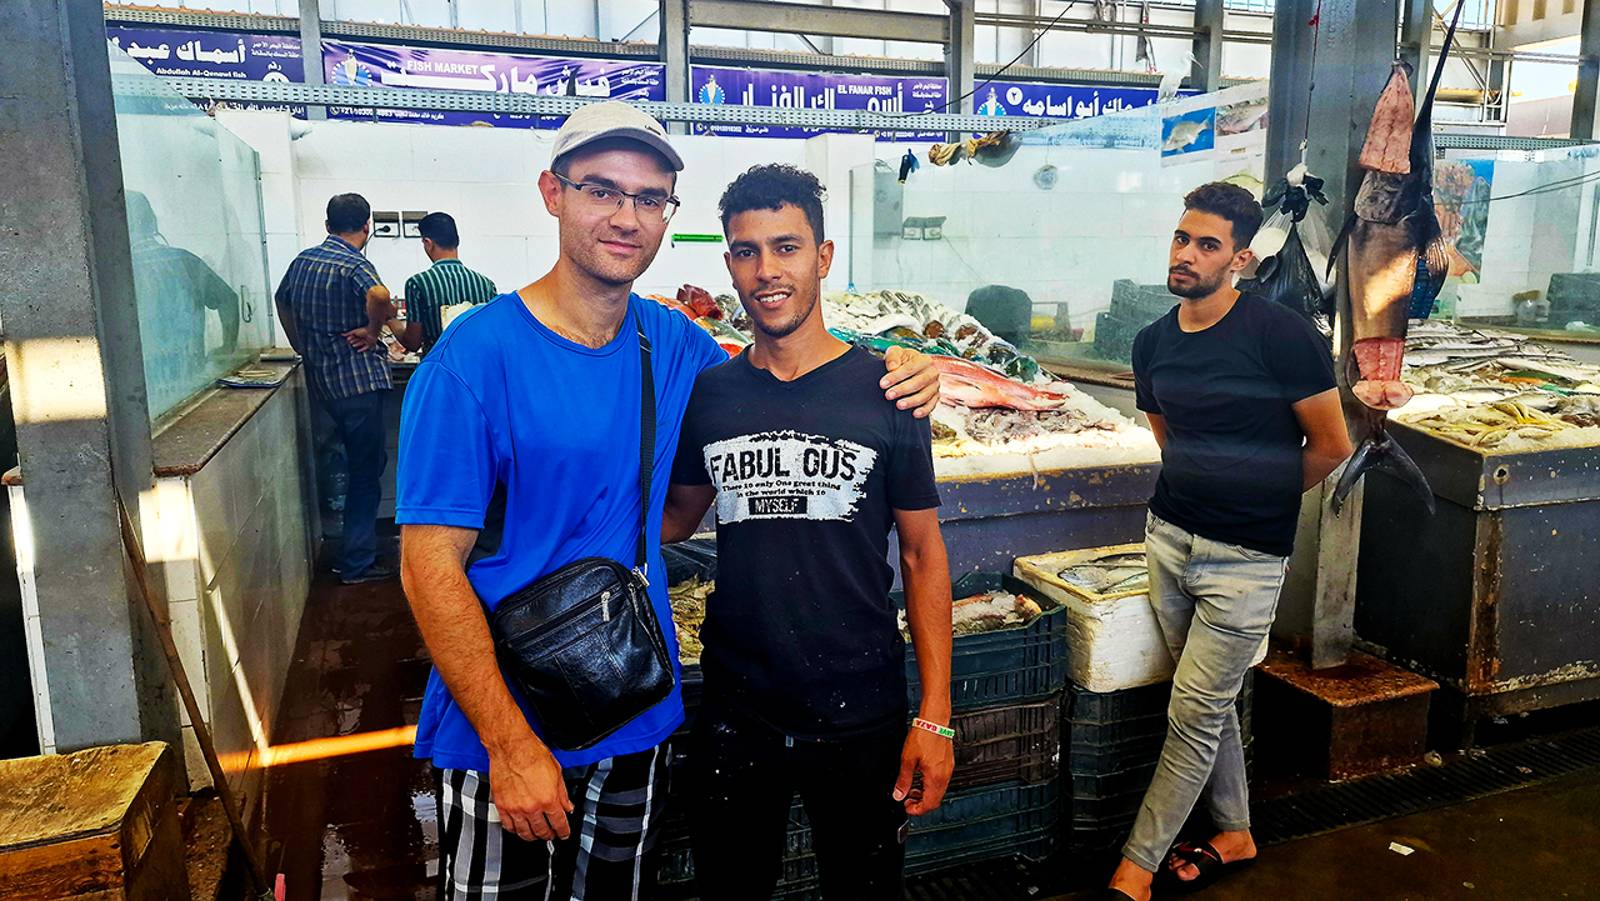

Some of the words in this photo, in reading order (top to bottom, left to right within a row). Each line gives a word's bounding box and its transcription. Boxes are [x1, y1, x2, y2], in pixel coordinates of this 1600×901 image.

[127, 42, 170, 65] عبد
[176, 38, 245, 64] أسماك
[406, 61, 432, 71] FISH
[434, 63, 479, 74] MARKET
[837, 84, 848, 94] EL
[848, 85, 874, 95] FANAR
[875, 85, 892, 95] FISH
[755, 481, 774, 489] only
[775, 479, 792, 487] One
[817, 481, 841, 491] thing
[761, 488, 786, 496] world
[788, 488, 815, 496] which
[754, 498, 800, 513] MYSELF
